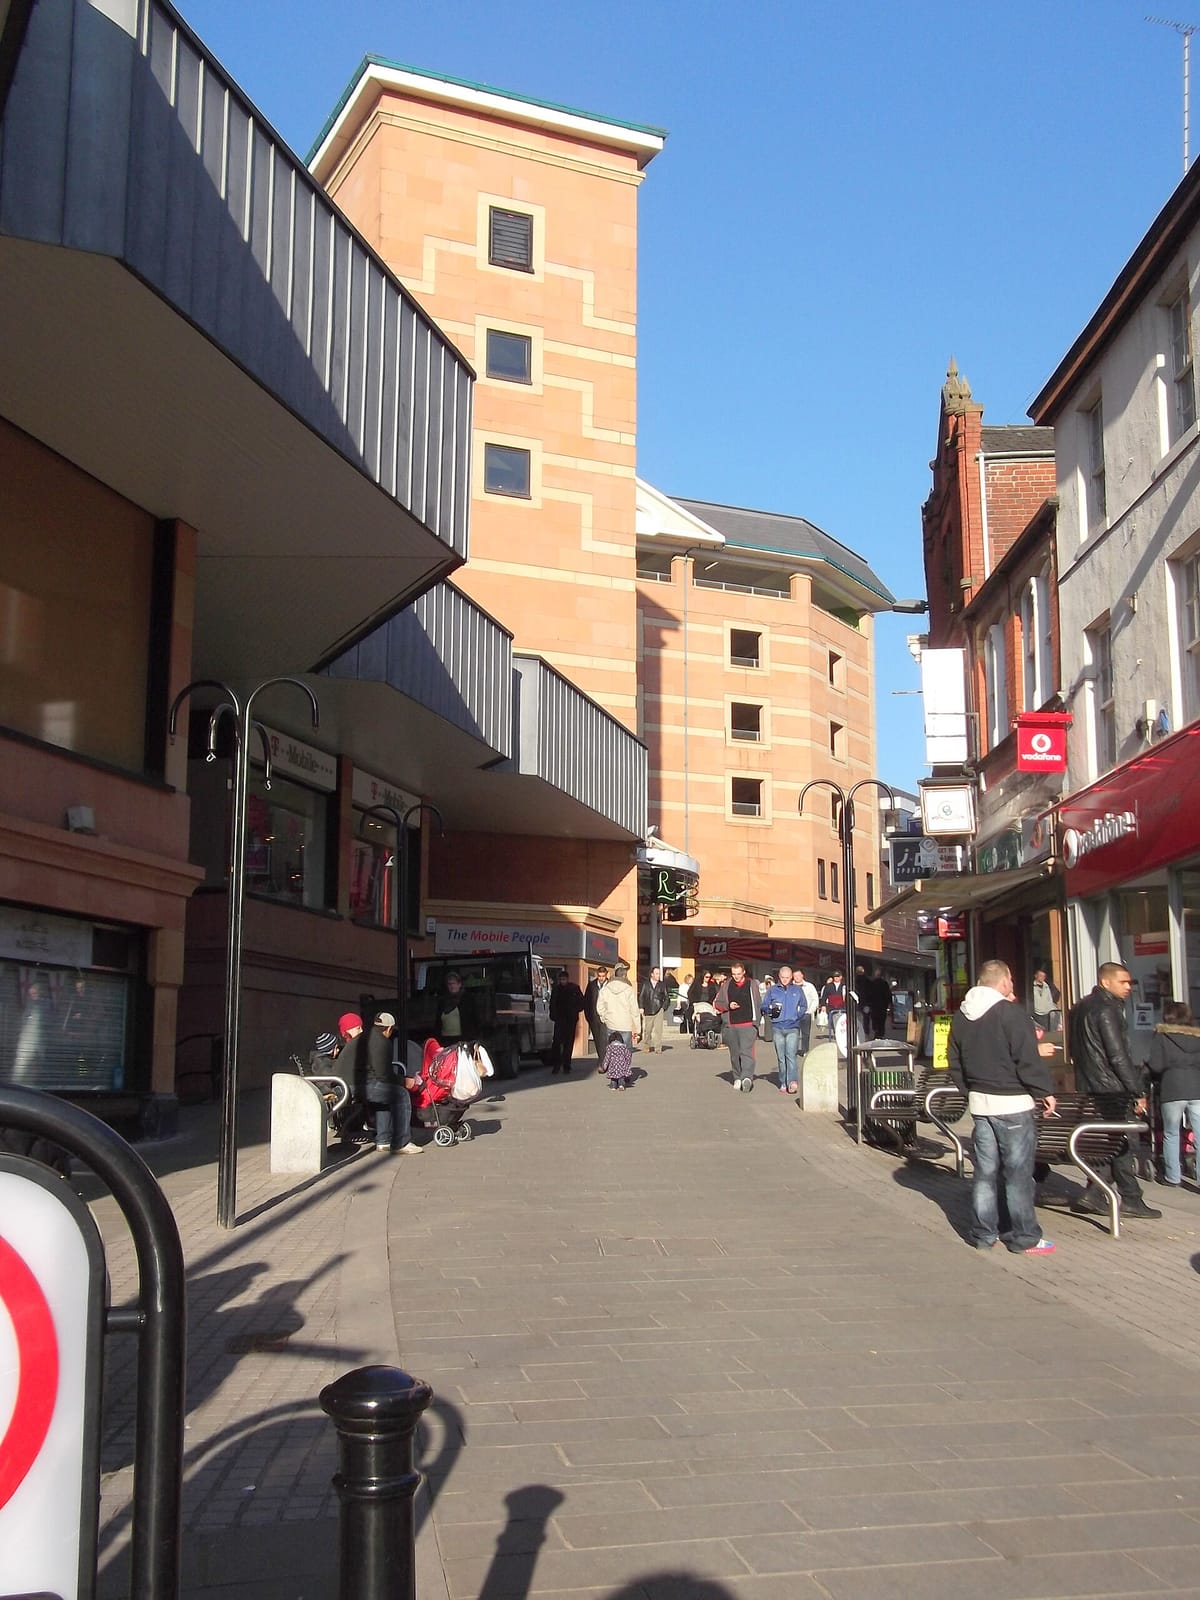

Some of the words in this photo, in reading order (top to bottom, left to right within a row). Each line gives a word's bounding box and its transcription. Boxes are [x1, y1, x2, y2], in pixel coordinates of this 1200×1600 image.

[1021, 753, 1062, 762] vodafone
[1078, 811, 1136, 858] vodafone
[447, 928, 468, 941] The
[470, 930, 510, 943] Mobile
[512, 932, 550, 945] People
[698, 939, 728, 956] bm
